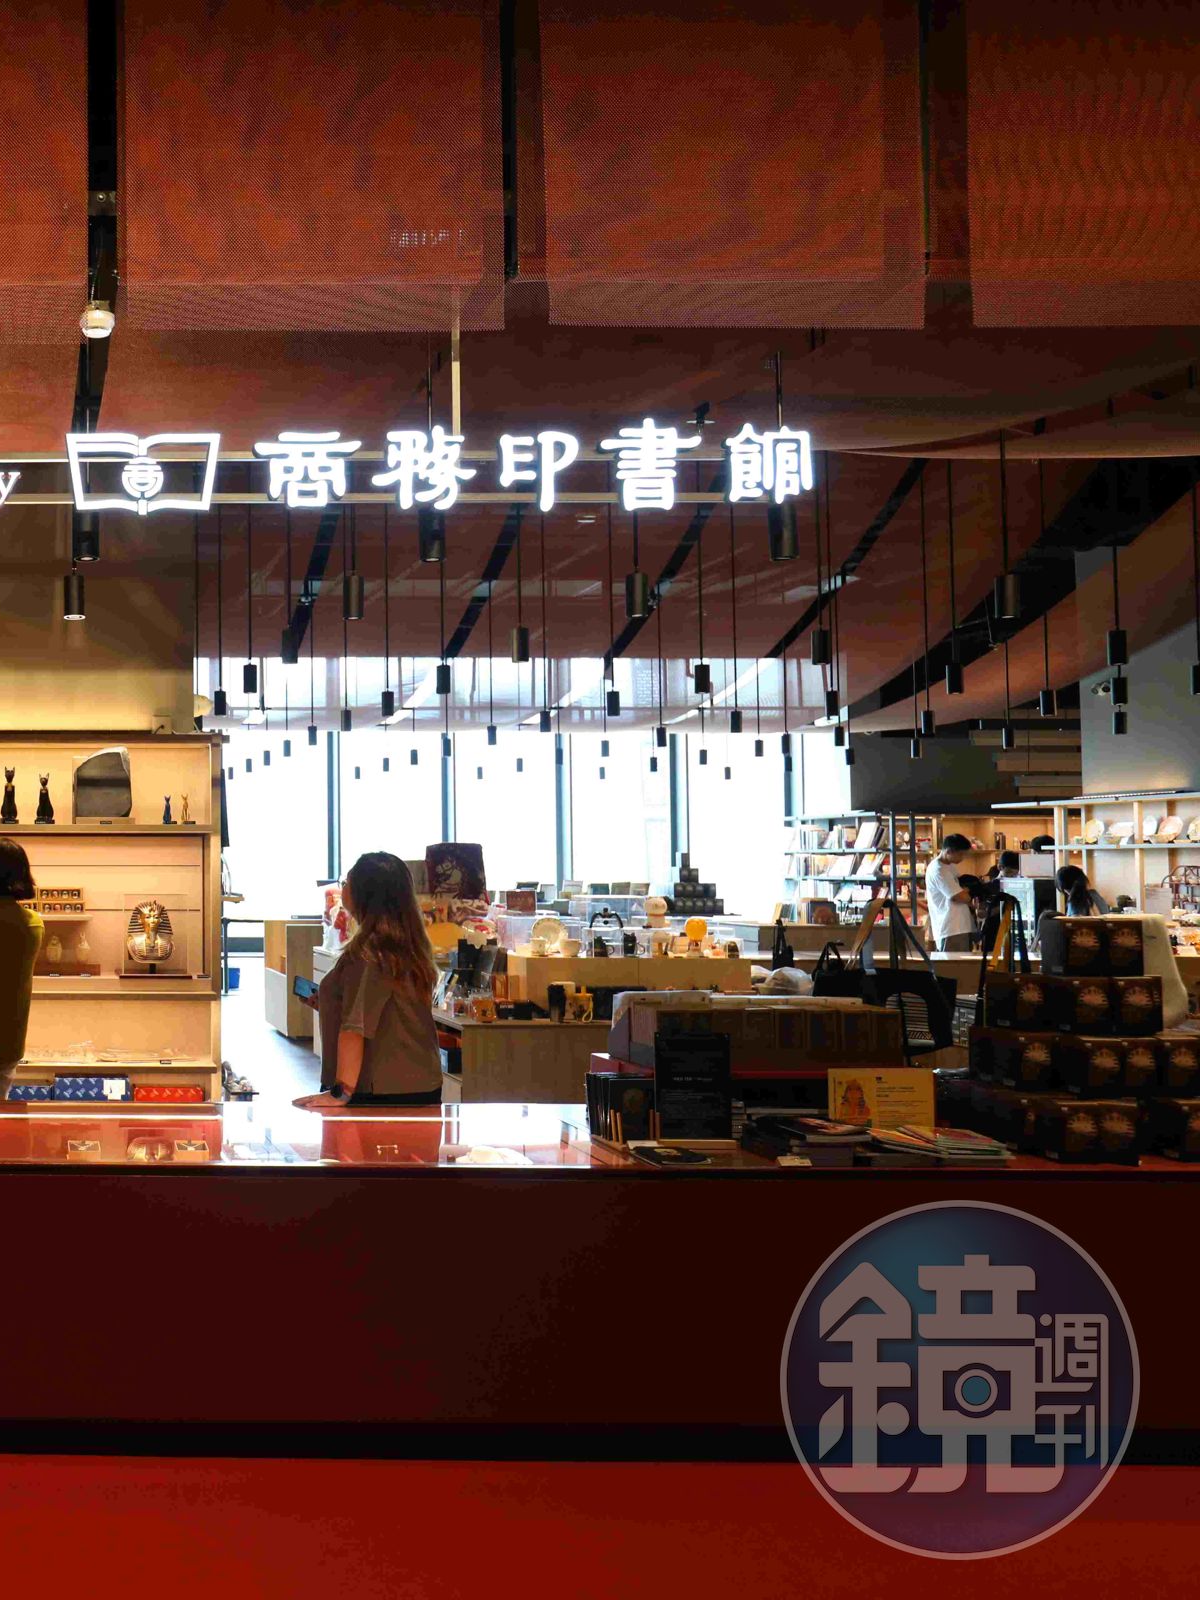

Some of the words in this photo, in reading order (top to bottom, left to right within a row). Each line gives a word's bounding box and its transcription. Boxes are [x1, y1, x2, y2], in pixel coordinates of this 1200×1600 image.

[253, 417, 814, 513] 商務印書館
